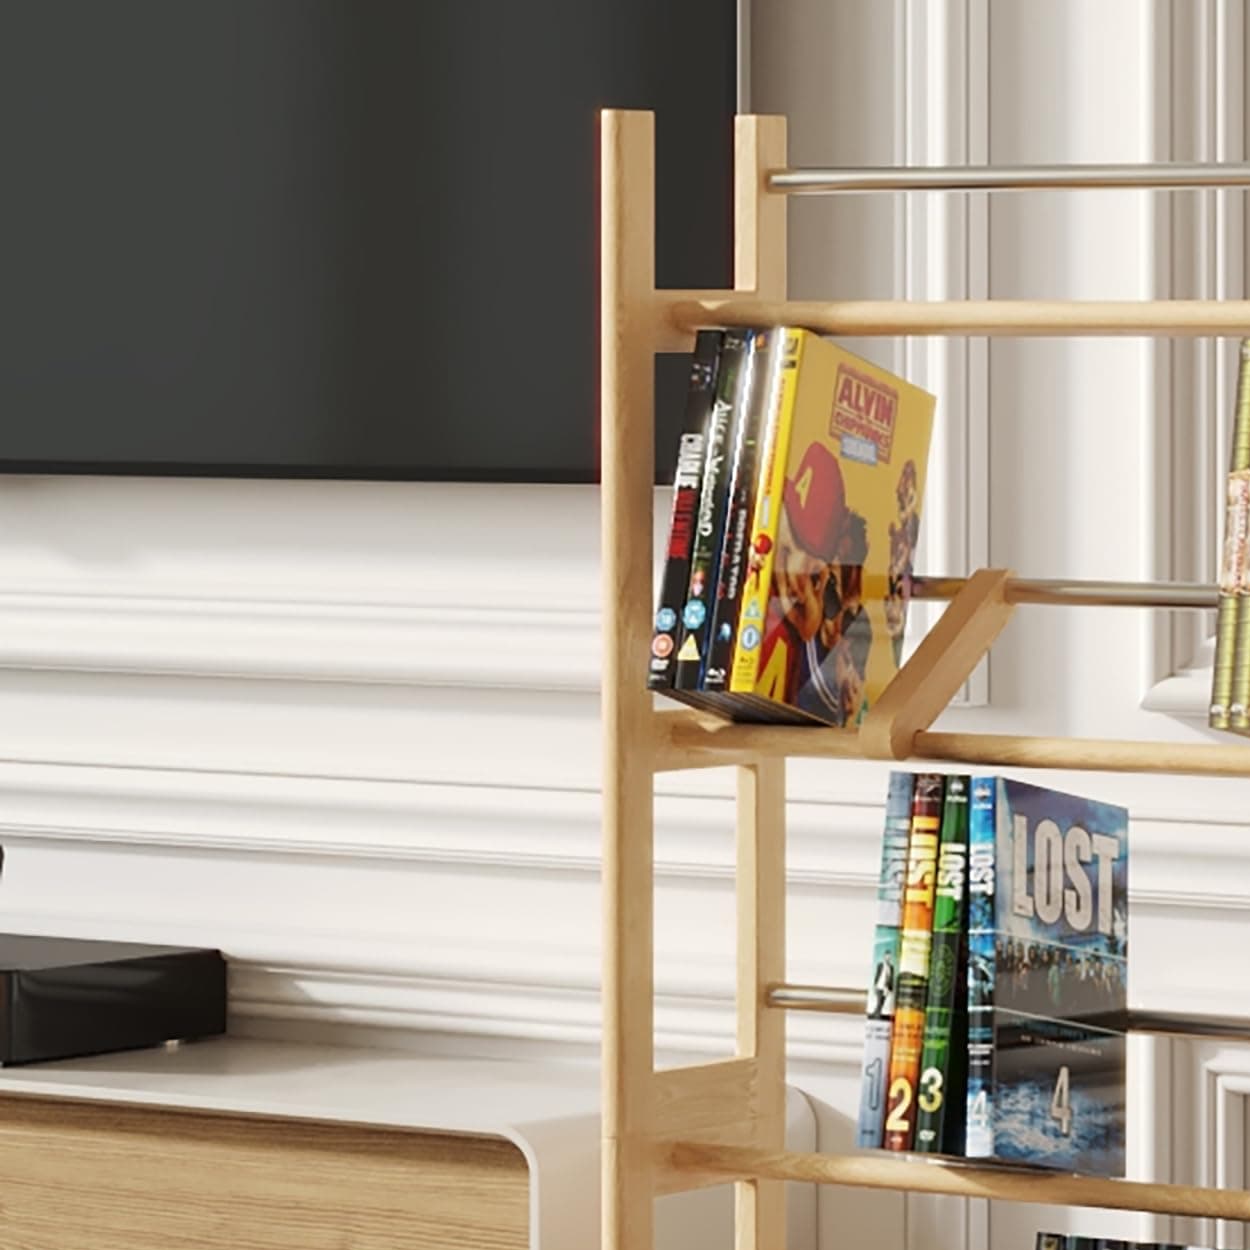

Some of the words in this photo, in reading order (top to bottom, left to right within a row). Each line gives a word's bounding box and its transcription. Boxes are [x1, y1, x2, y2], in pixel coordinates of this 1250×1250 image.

[838, 377, 895, 427] ALVIN
[676, 433, 704, 489] CHARLIE
[905, 816, 938, 909] LOST
[936, 843, 966, 901] LOST
[969, 843, 994, 896] LOST
[1013, 813, 1119, 936] LOST
[865, 1057, 882, 1111] 1
[886, 1077, 911, 1131] 2
[918, 1066, 943, 1112] 3
[971, 1090, 988, 1128] 4
[1051, 1066, 1072, 1134] 4
